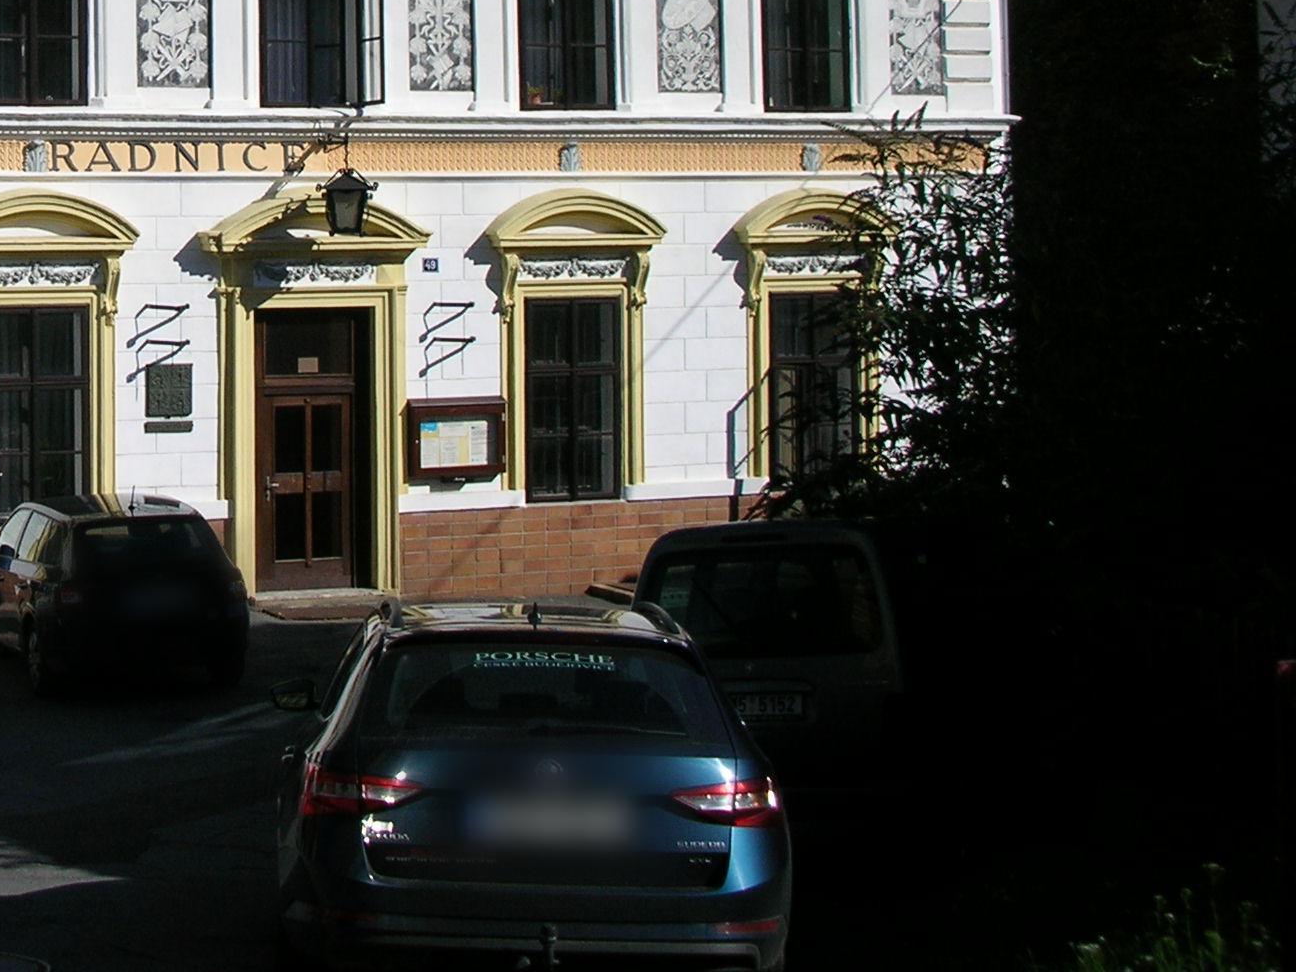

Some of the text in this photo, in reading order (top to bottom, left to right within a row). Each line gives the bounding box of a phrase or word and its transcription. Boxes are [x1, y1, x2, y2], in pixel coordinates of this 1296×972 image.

[48, 140, 307, 173] RADNICE
[424, 259, 437, 270] 49
[475, 651, 615, 666] PORSCHE
